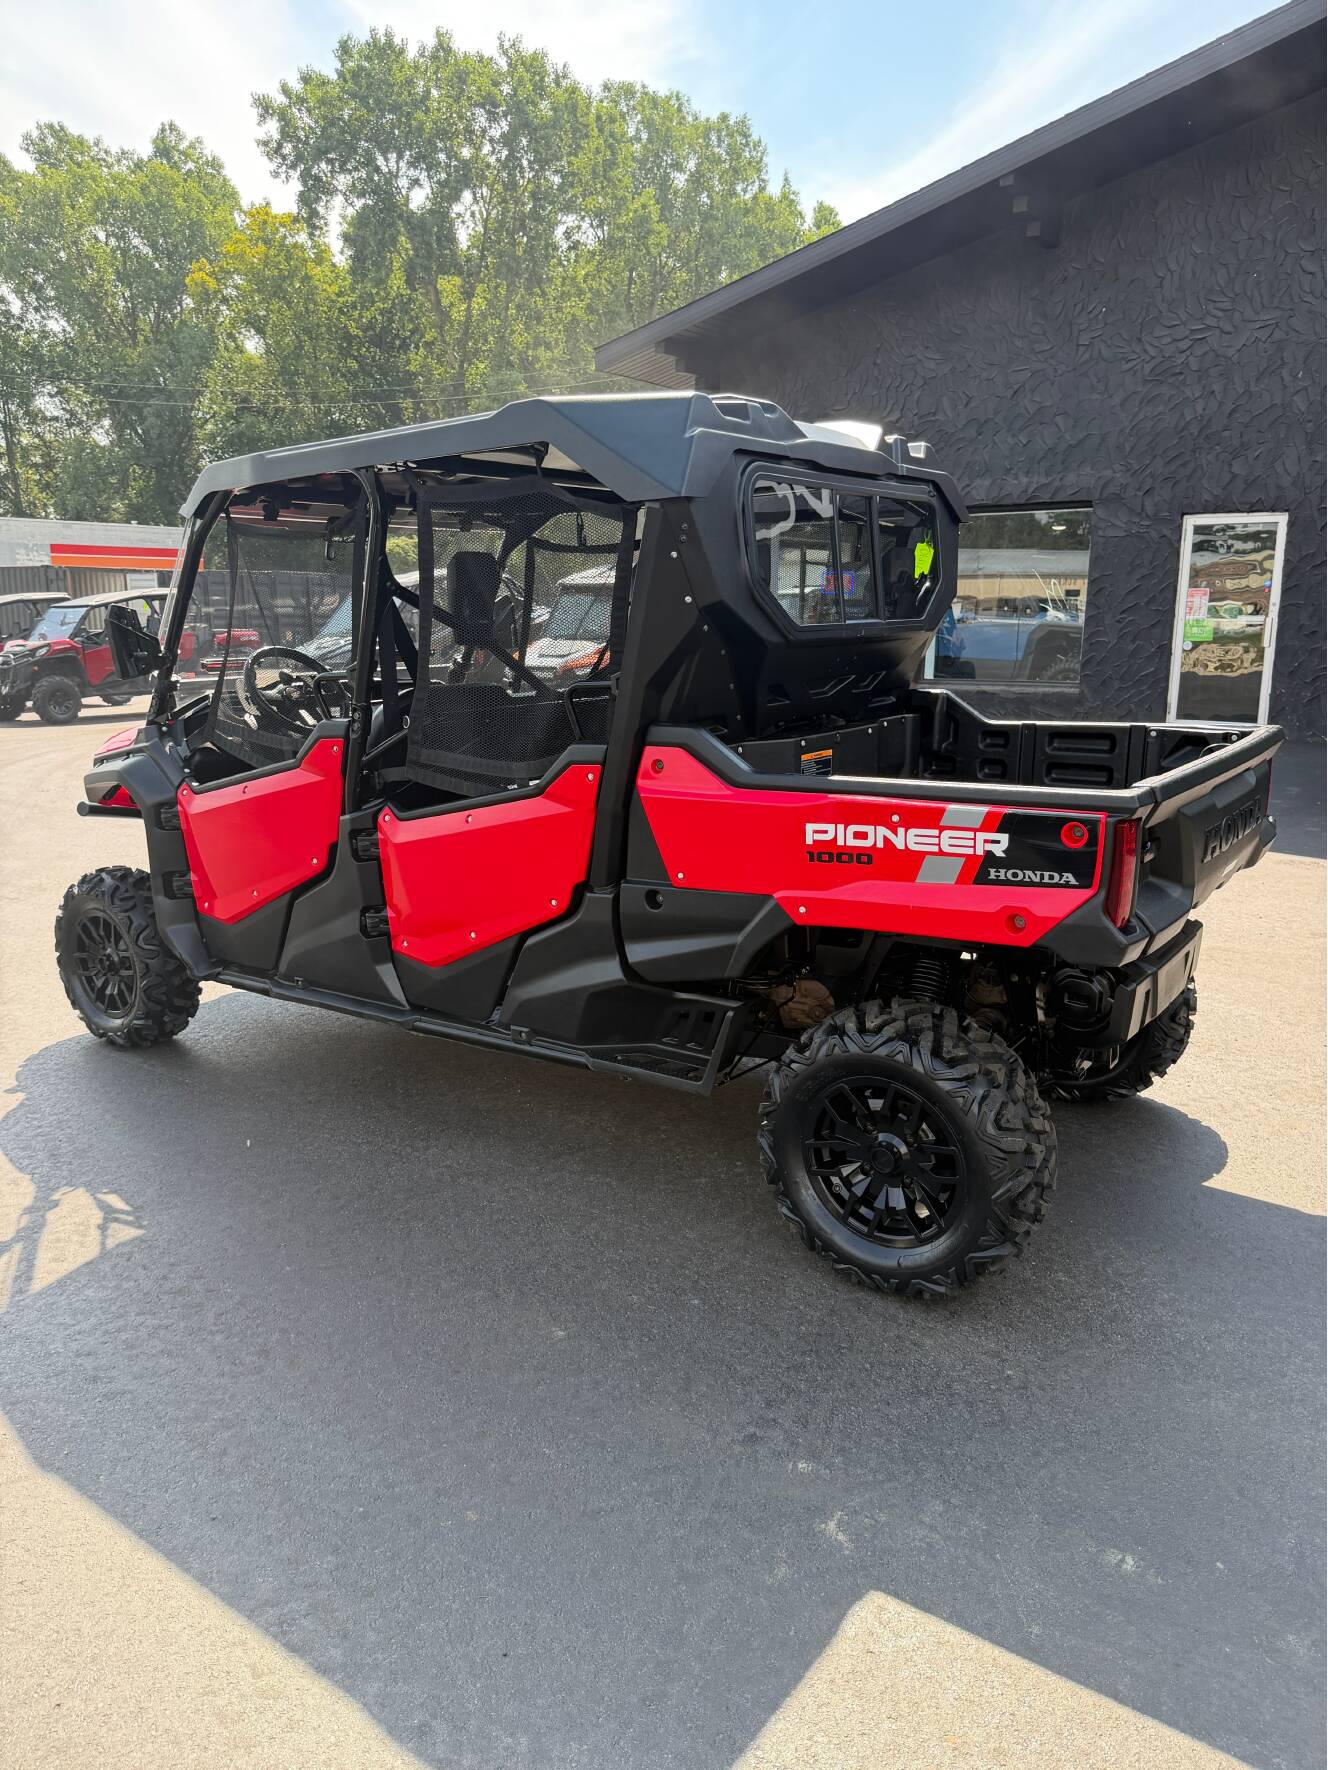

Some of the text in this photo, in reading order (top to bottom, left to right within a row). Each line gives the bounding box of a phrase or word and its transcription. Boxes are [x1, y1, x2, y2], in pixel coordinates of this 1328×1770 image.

[805, 823, 1009, 857] PIONEER
[1202, 796, 1262, 863] HONDA
[806, 851, 873, 865] 1000
[988, 868, 1079, 885] HONDA
